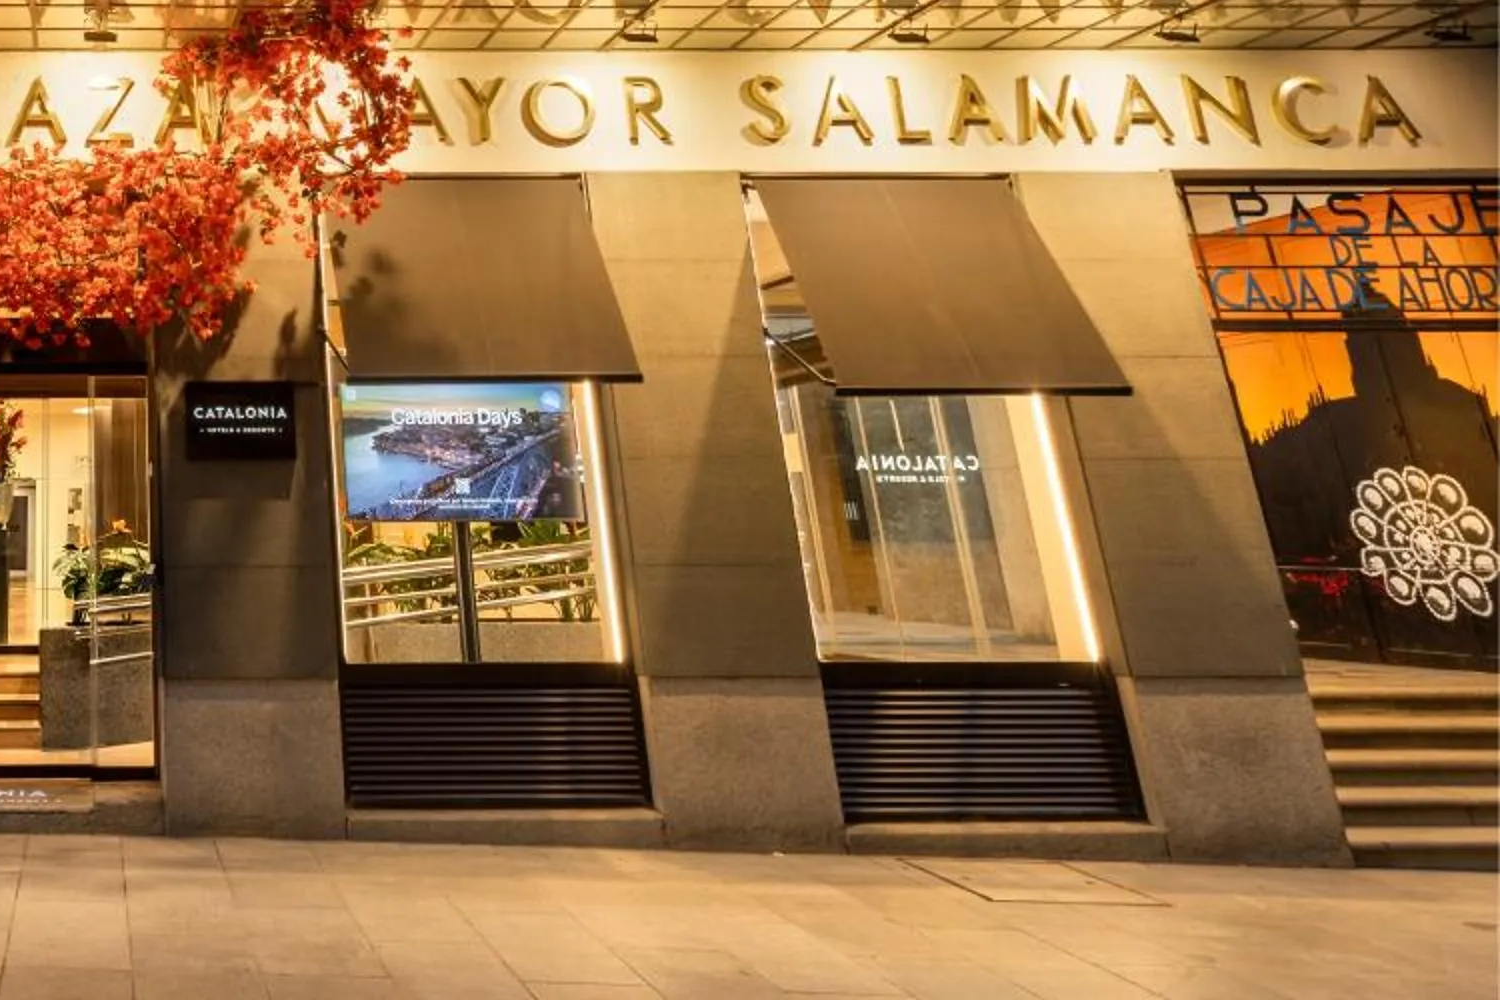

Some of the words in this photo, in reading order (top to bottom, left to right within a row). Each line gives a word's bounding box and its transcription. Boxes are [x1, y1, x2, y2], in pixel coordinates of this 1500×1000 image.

[741, 74, 1423, 148] SALAMANCA
[1228, 191, 1498, 236] PASAJE
[1329, 235, 1379, 268] DE
[1390, 235, 1444, 268] LA
[1208, 267, 1327, 311] CAJA
[192, 406, 288, 420] CATALONIA
[391, 408, 475, 425] Catalonia
[477, 408, 524, 428] Days
